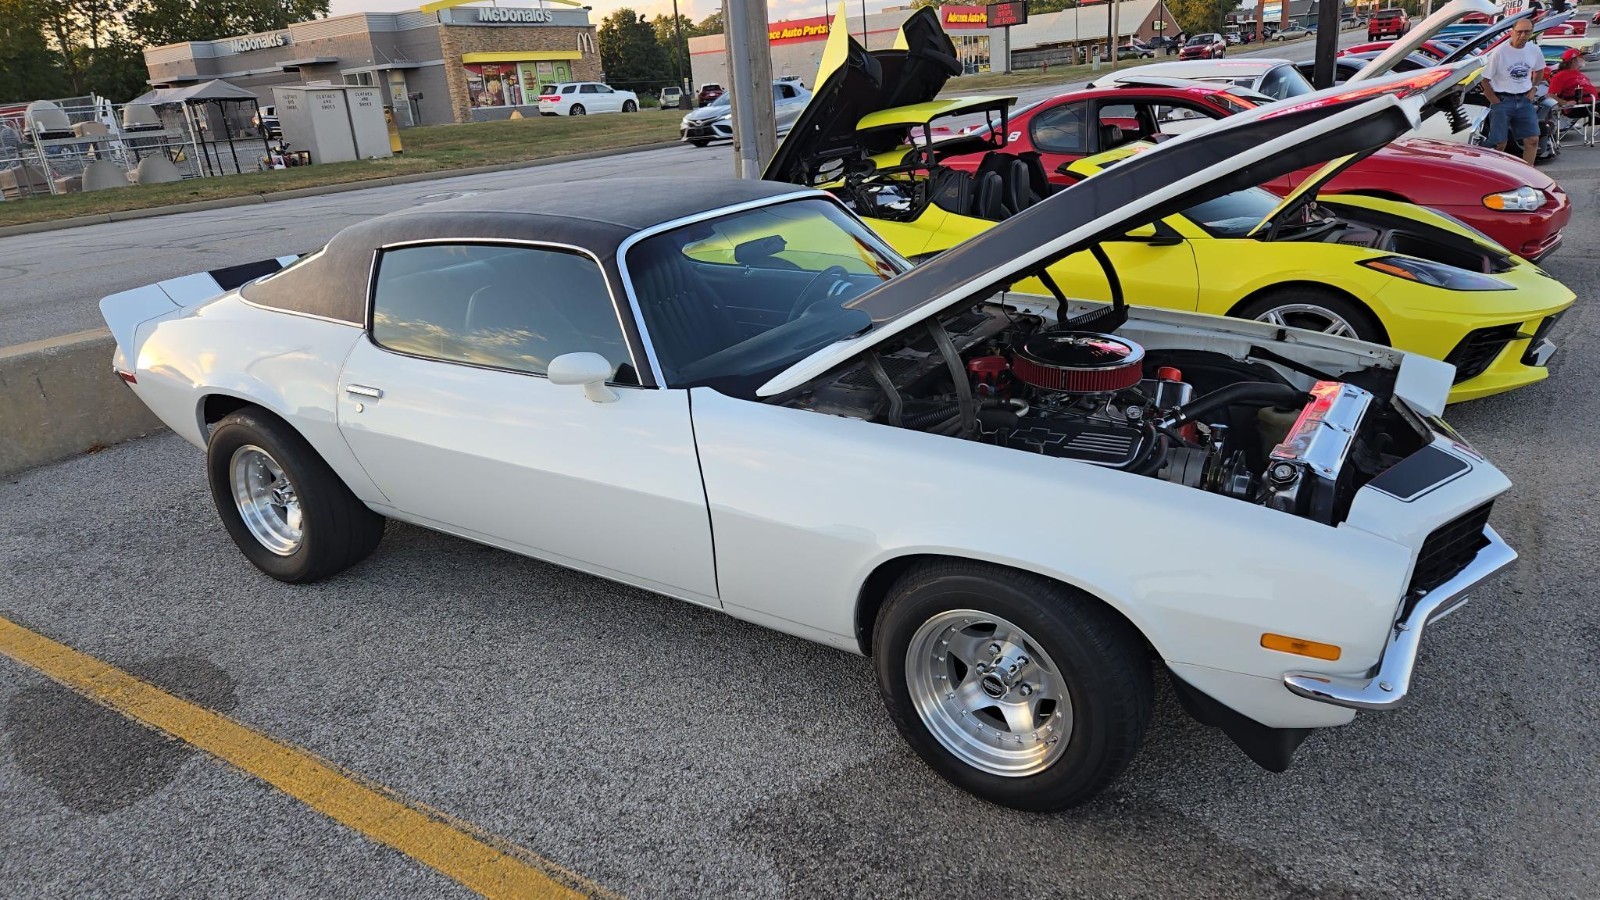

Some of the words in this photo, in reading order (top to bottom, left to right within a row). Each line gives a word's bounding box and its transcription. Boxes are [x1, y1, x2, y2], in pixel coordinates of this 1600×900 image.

[479, 7, 553, 22] McDonald's
[947, 12, 969, 23] Advance
[780, 28, 802, 38] Auto
[802, 24, 828, 36] Parts
[230, 33, 284, 53] McDonald's
